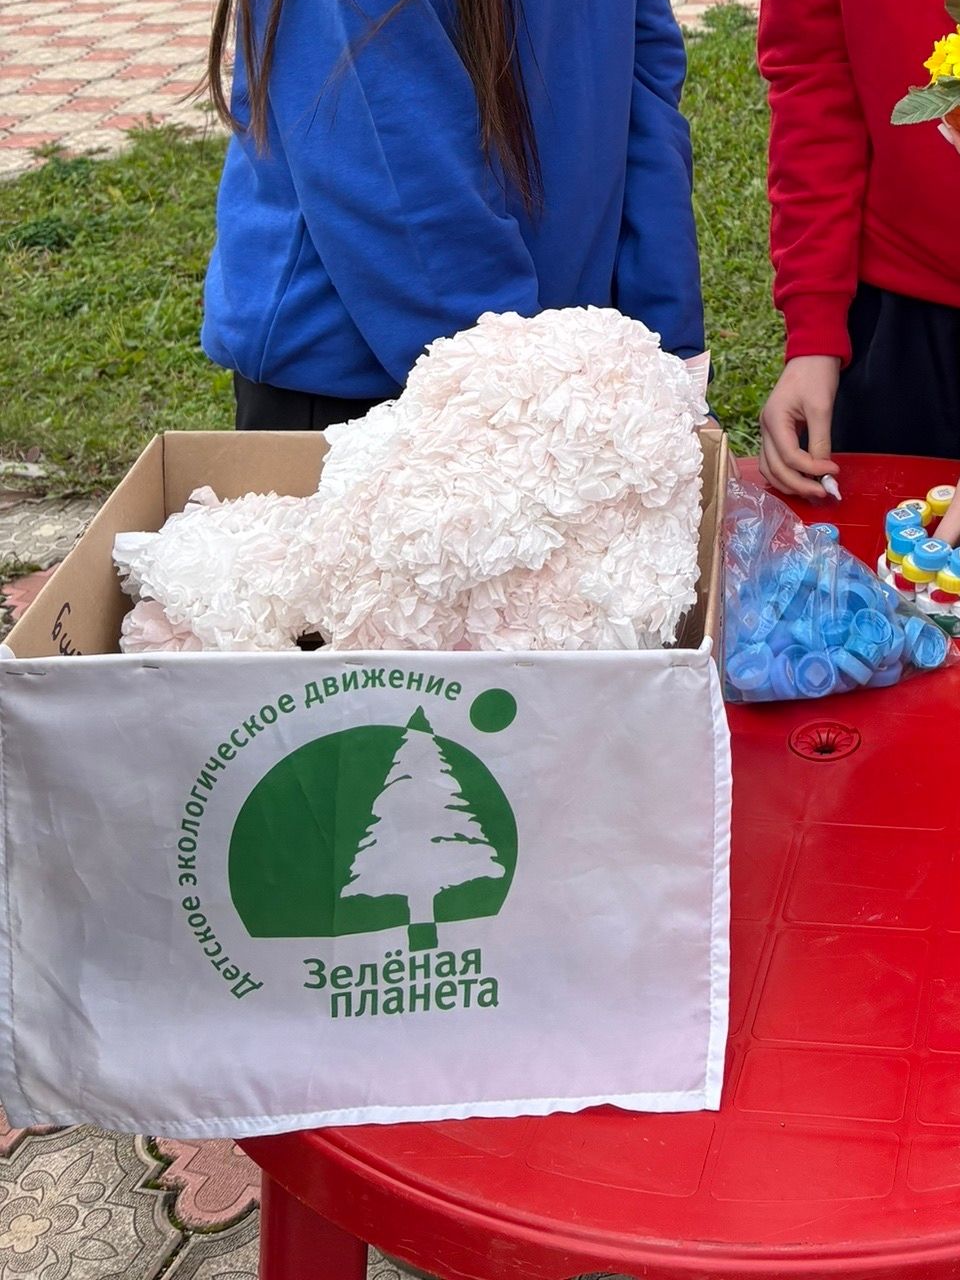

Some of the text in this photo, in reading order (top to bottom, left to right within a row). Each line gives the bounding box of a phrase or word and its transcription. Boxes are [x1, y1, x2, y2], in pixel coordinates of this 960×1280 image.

[178, 668, 462, 999] Детское экологическое движение
[303, 948, 482, 990] Зелёная
[330, 976, 499, 1018] планета
